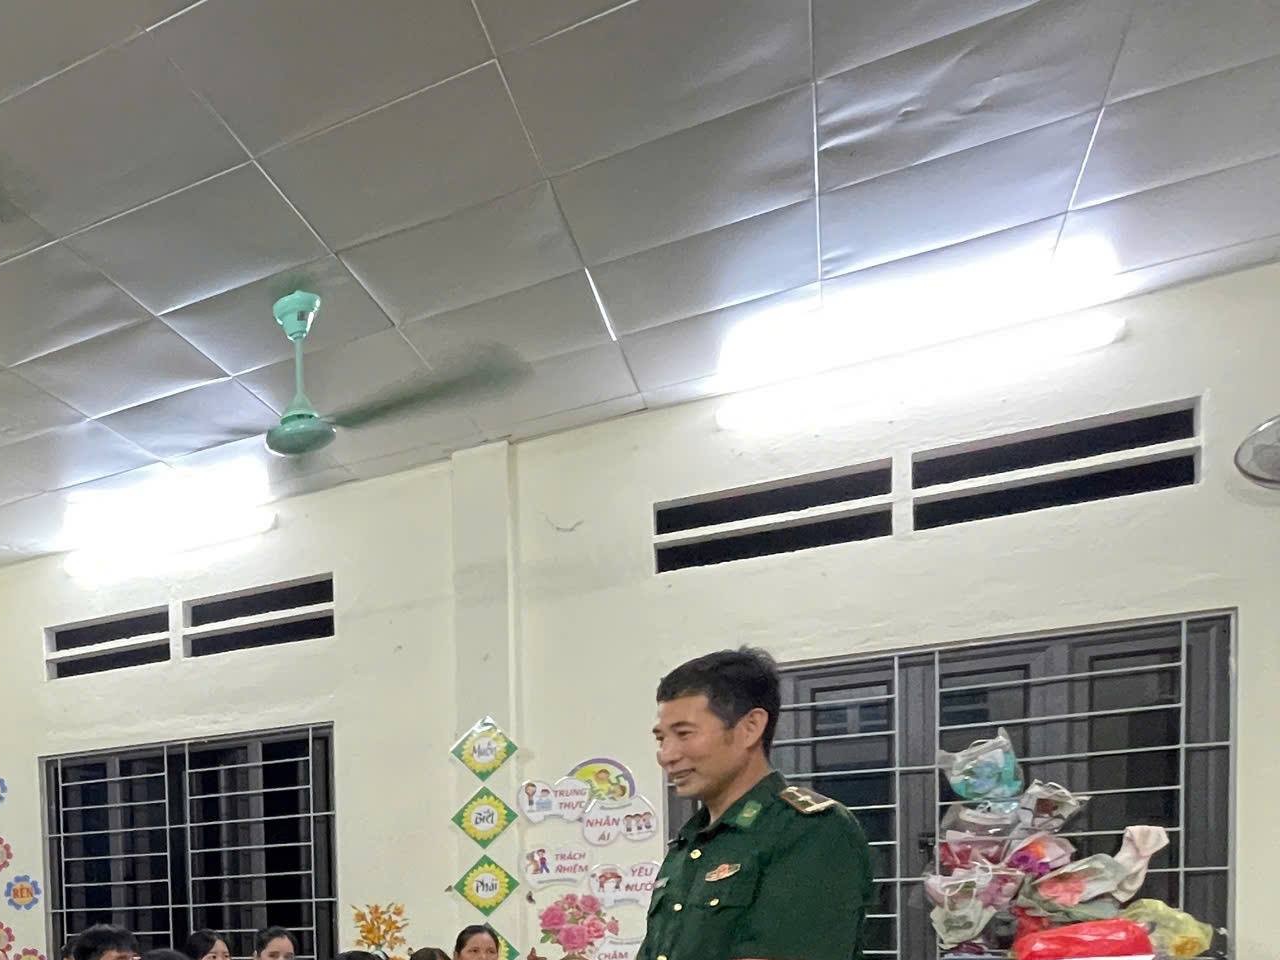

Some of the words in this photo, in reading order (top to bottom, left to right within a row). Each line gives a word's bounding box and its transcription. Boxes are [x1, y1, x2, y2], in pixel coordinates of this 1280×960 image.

[554, 788, 587, 798] TRUNG
[585, 815, 620, 828] NHÂN
[554, 851, 586, 861] TRÁCH
[555, 863, 588, 874] NHIỆM
[631, 866, 654, 877] YÊU
[624, 880, 656, 892] NƯỚ
